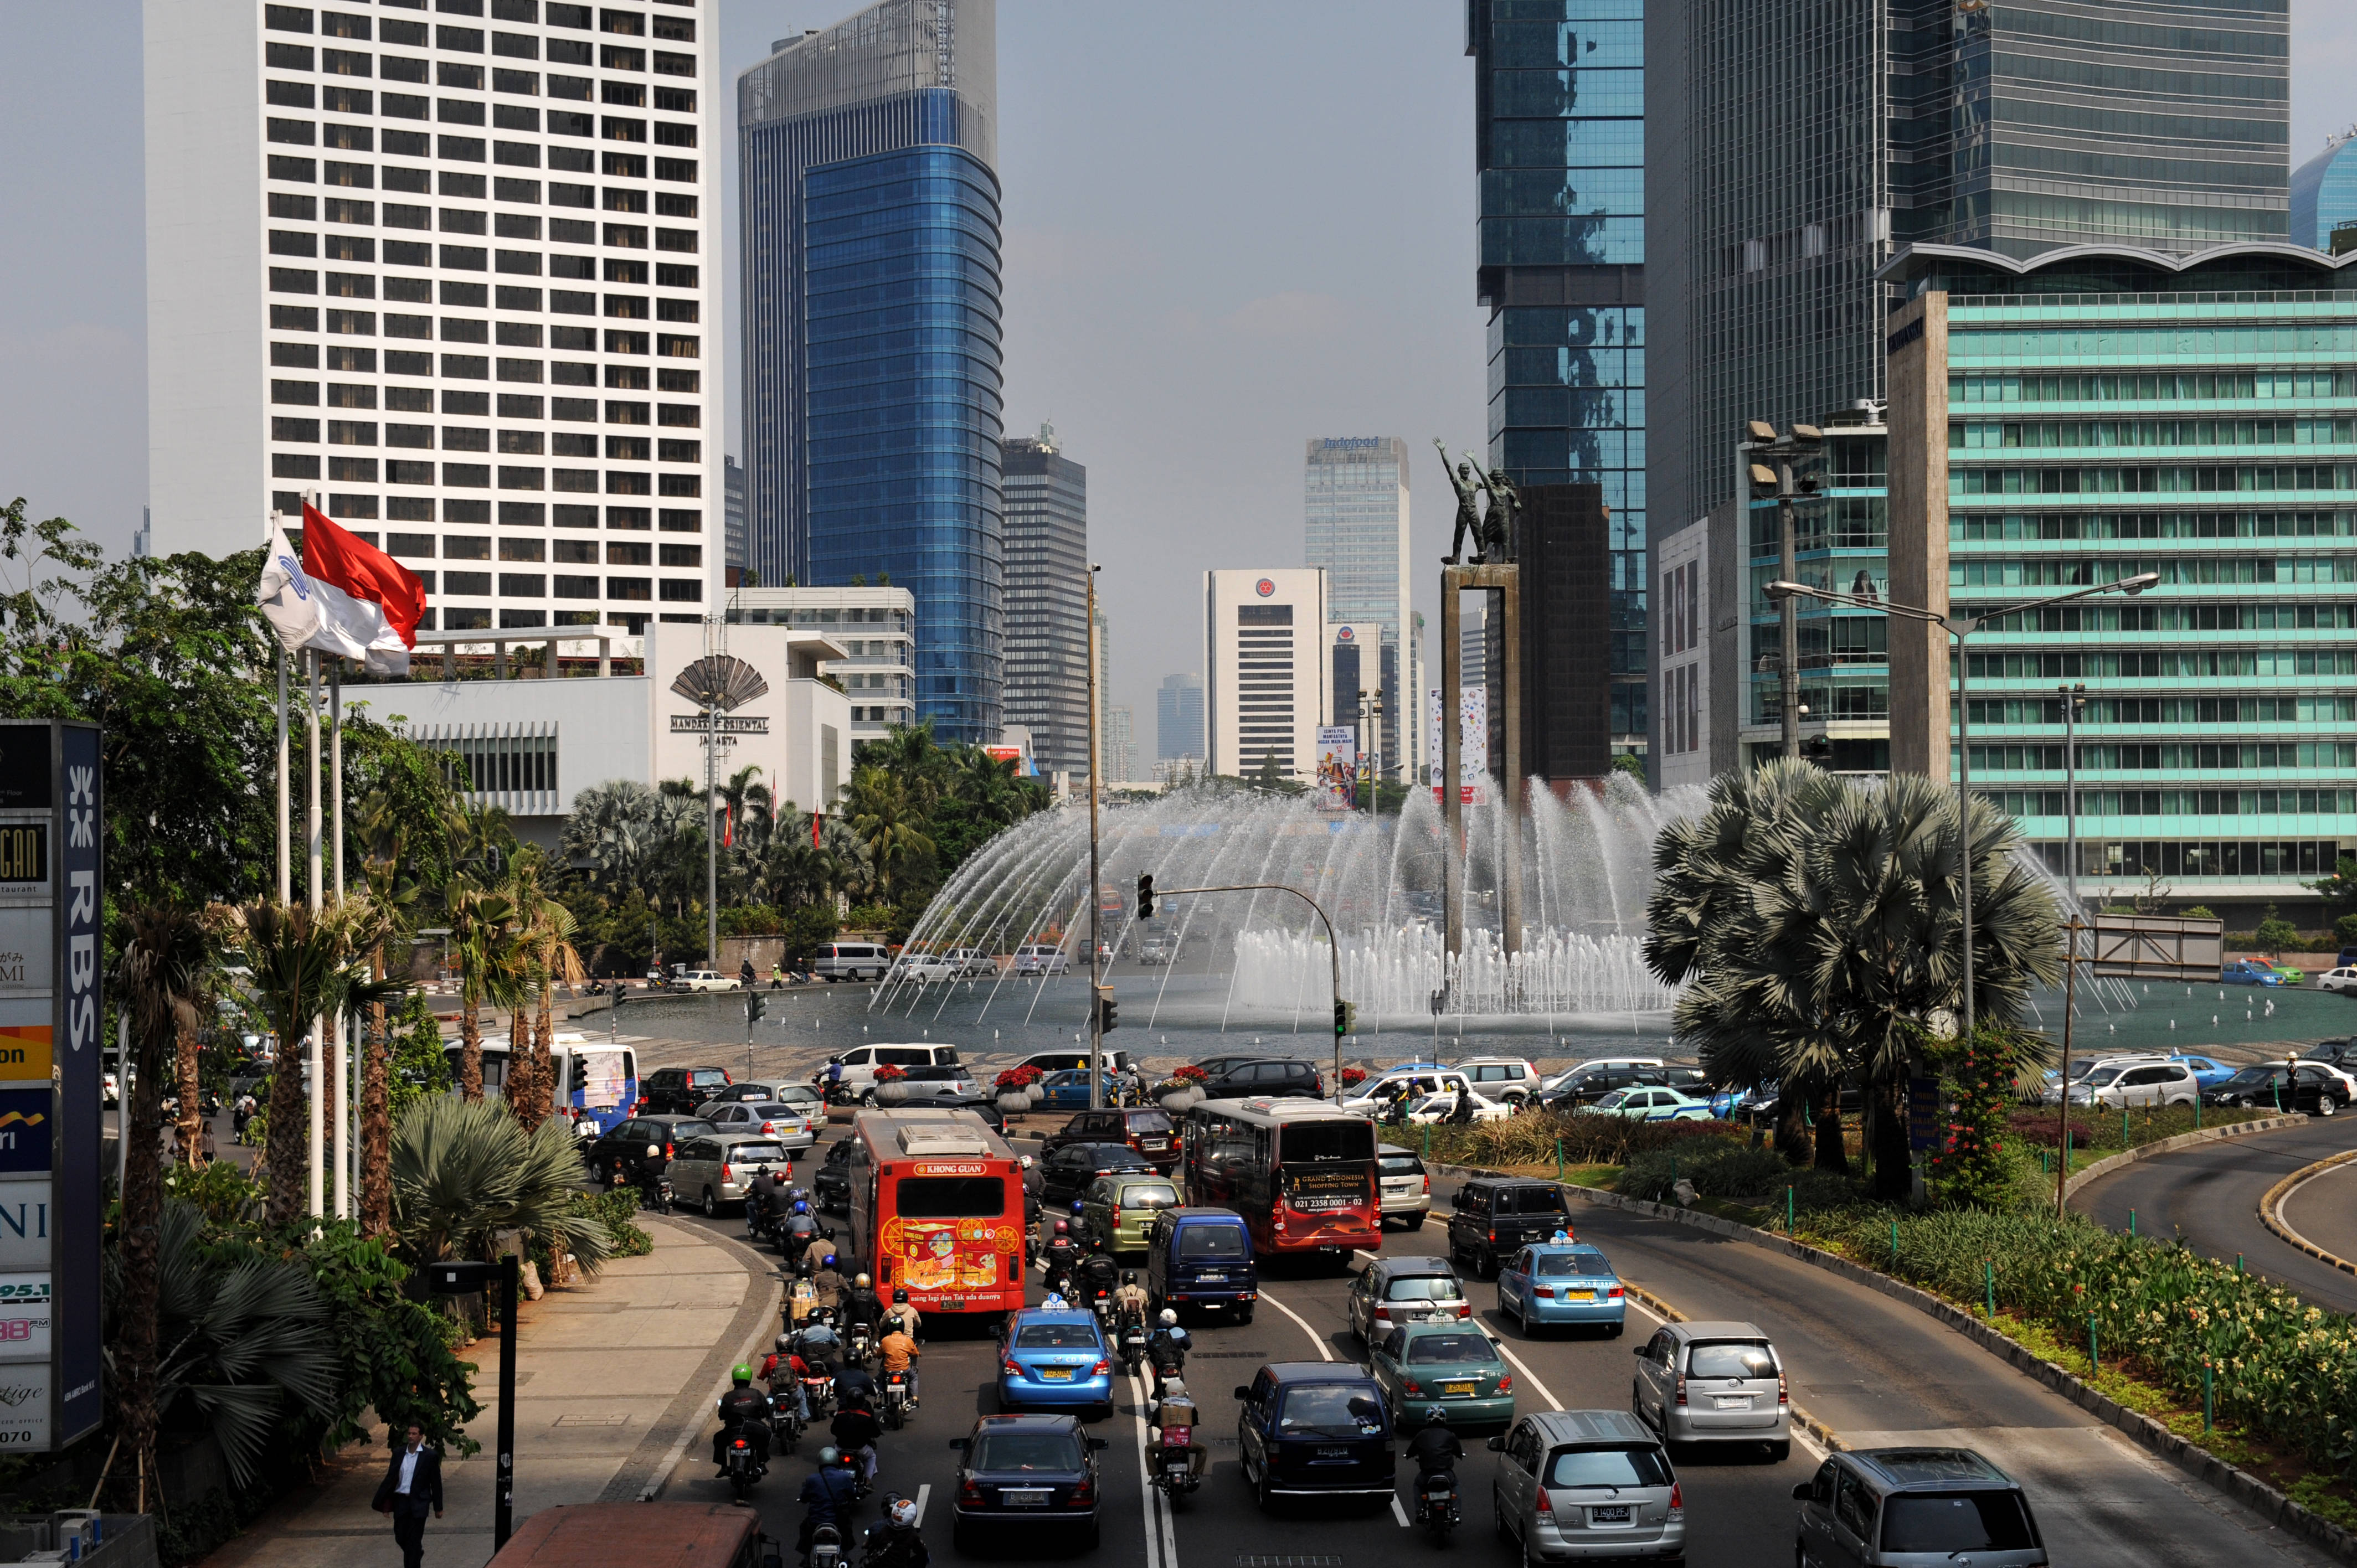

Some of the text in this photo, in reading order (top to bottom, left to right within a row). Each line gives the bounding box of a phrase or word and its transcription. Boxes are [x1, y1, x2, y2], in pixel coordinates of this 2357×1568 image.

[671, 718, 769, 730] MANDARN ORIENTAL
[699, 735, 737, 747] JAARTA
[70, 870, 94, 1051] RBS
[0, 1049, 24, 1063] on
[927, 1165, 956, 1173] KHONG
[0, 1203, 47, 1239] NI
[0, 1431, 32, 1443] 070
